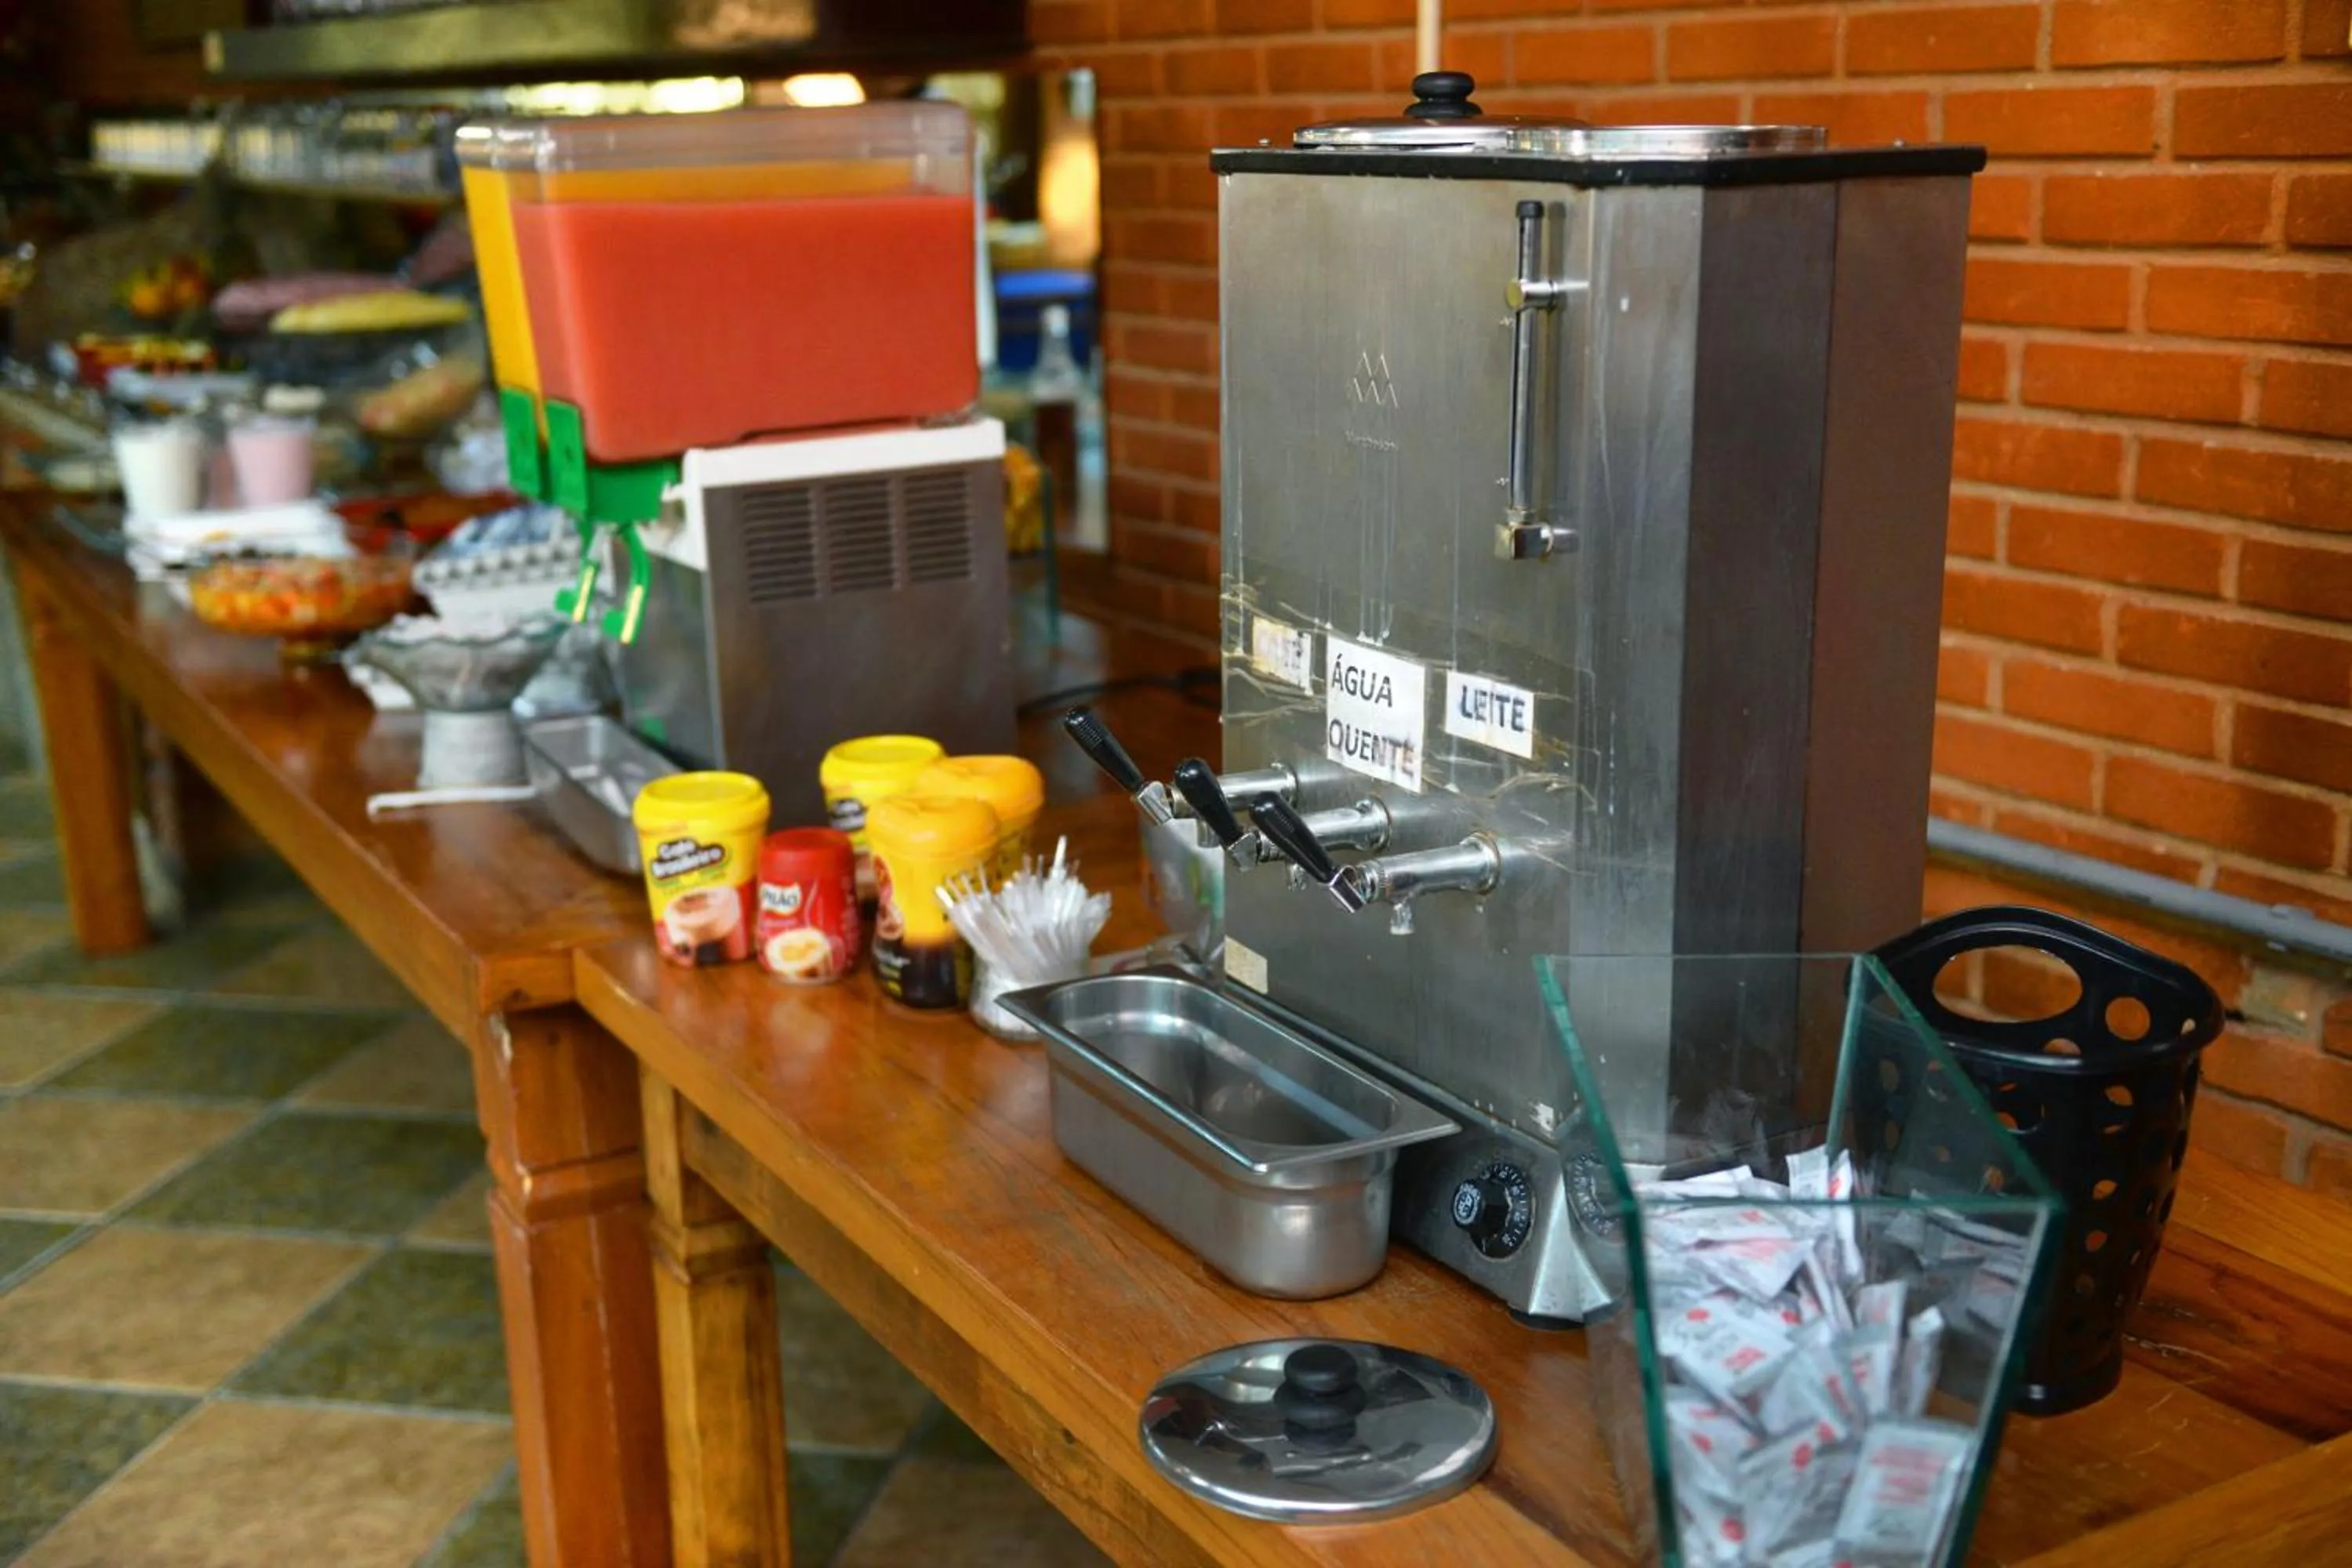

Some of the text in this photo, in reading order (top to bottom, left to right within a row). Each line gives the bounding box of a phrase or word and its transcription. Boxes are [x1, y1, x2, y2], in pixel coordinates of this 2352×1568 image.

[1332, 652, 1392, 708] ÁGUA
[1461, 684, 1525, 733] LEITE
[1329, 718, 1414, 778] QUENTE
